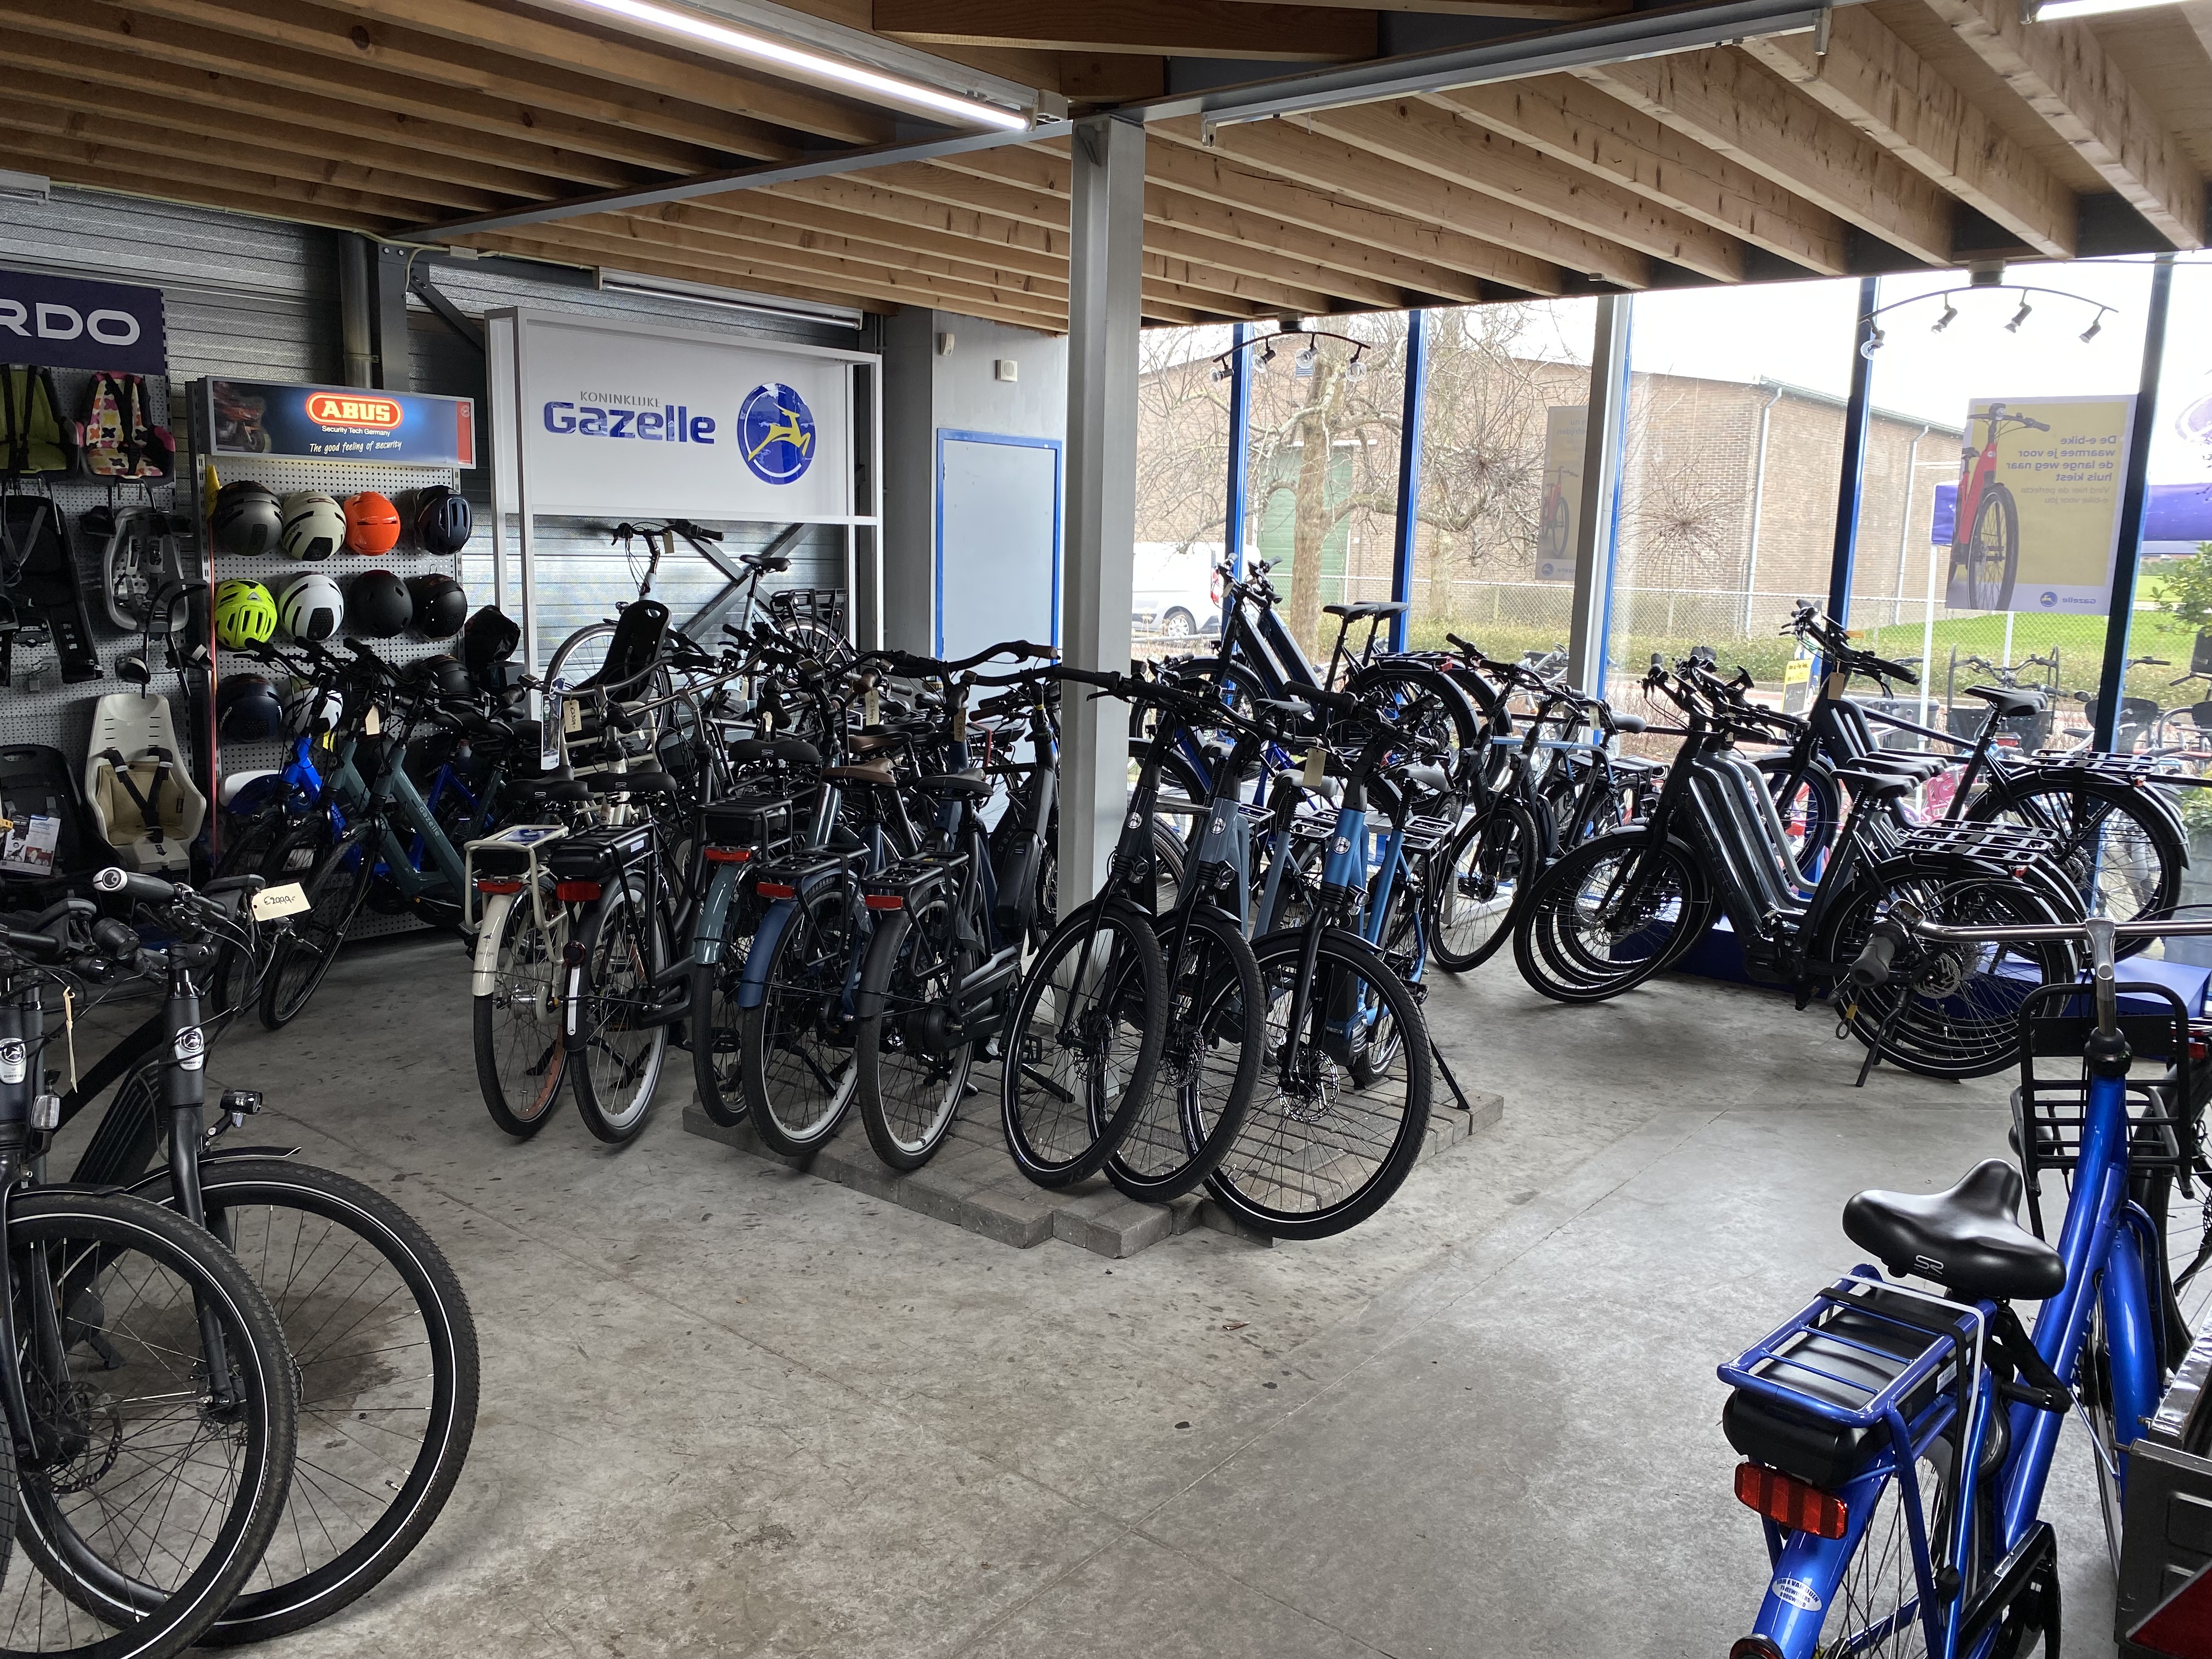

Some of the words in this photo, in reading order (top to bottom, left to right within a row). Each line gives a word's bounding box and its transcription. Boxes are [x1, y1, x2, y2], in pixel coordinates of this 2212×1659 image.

[0, 298, 140, 346] RDO
[321, 400, 390, 422] ABUS
[580, 391, 661, 408] KONINKLIJKE
[321, 425, 347, 434] Security
[364, 428, 391, 437] Germany
[544, 401, 716, 444] Gazelle
[309, 443, 321, 453] The
[324, 442, 340, 455] good
[342, 441, 364, 453] feeling
[366, 440, 374, 450] of
[375, 441, 402, 451] security
[419, 806, 440, 837] Gazelle
[997, 823, 1017, 852] Gaze
